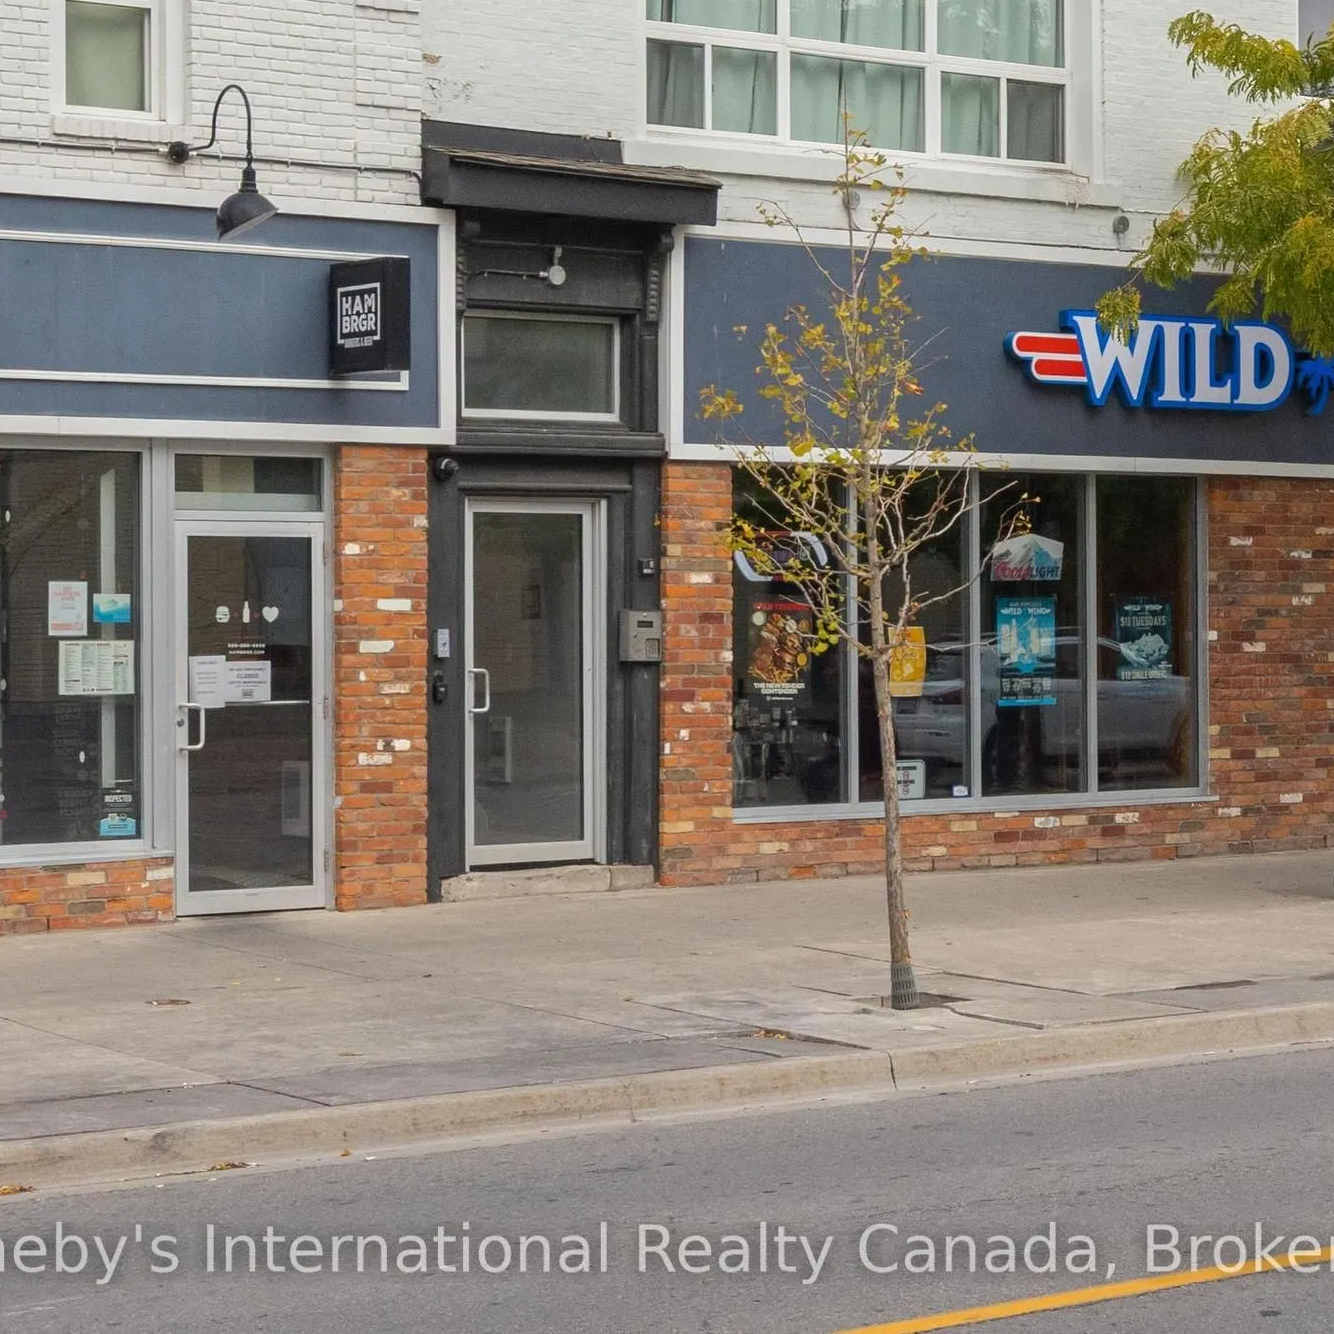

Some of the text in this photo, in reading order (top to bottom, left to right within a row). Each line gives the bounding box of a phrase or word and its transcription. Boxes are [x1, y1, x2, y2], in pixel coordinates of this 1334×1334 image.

[342, 293, 376, 316] HAM
[342, 313, 376, 334] BRGR
[1068, 312, 1293, 409] WILD
[1030, 566, 1060, 578] LIGHT
[1132, 615, 1167, 627] TUESDAYS
